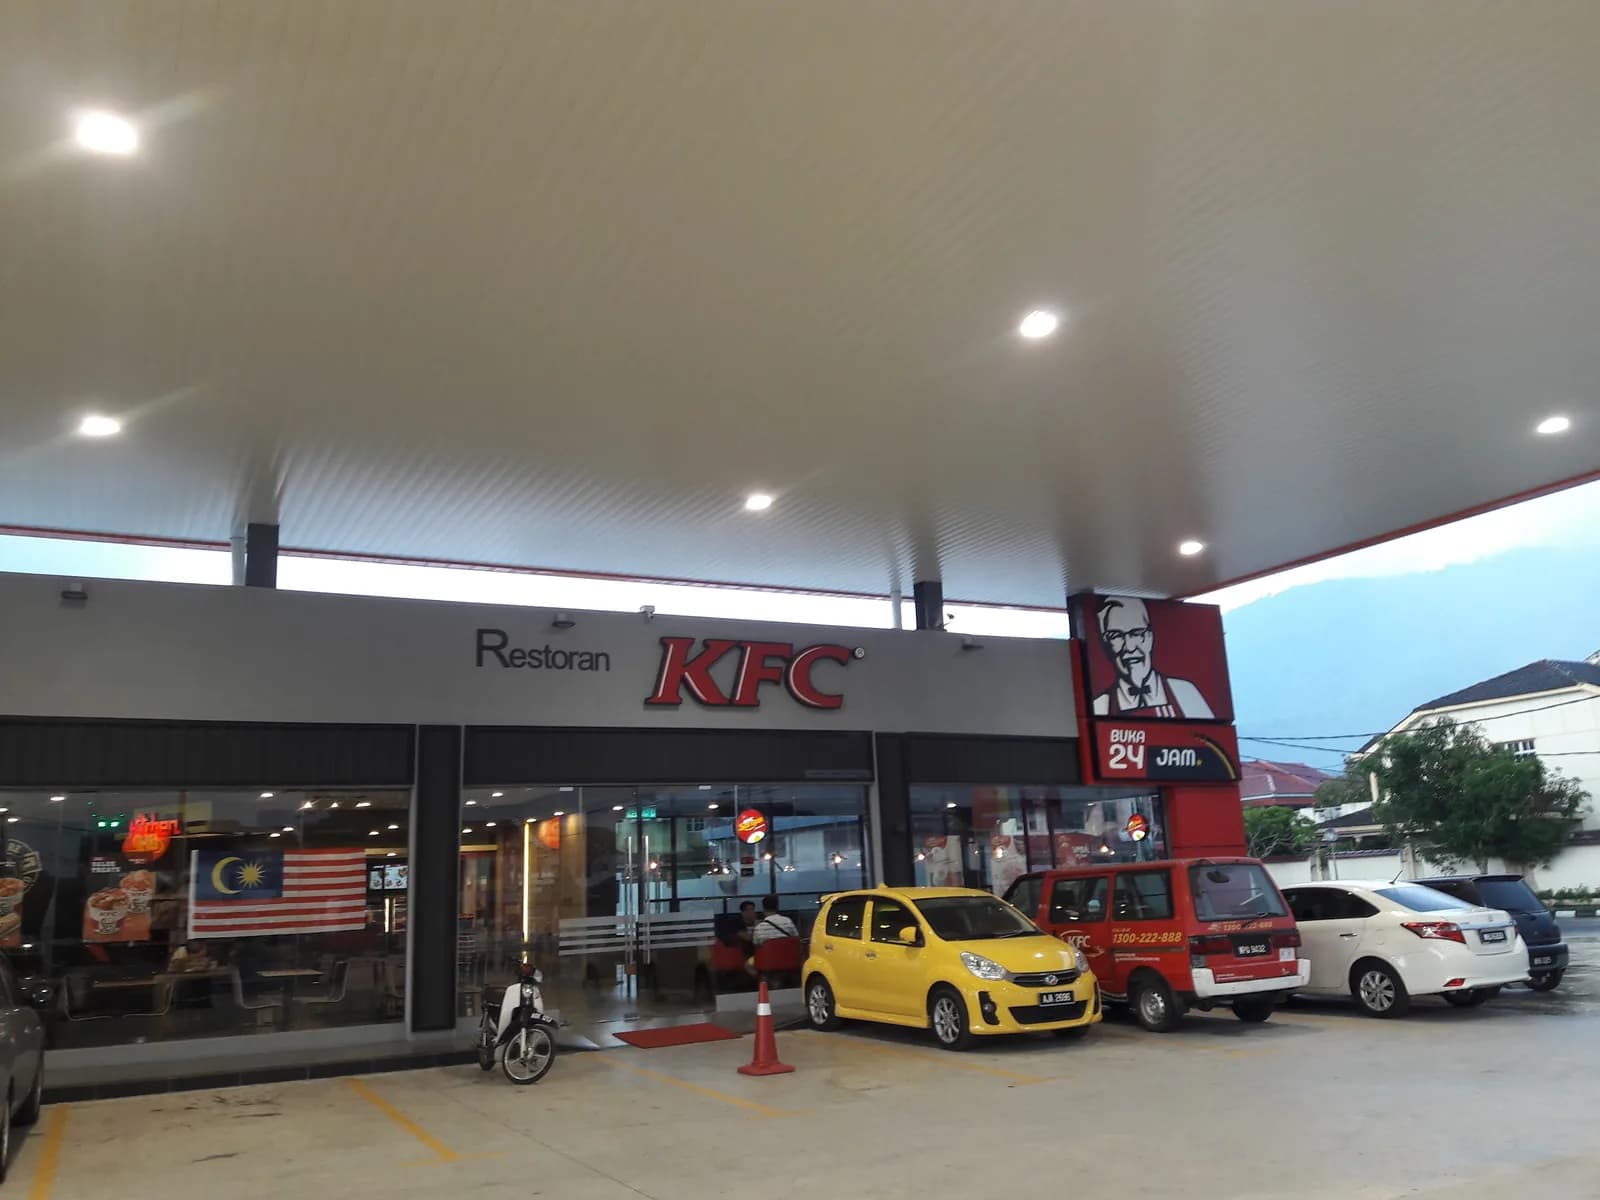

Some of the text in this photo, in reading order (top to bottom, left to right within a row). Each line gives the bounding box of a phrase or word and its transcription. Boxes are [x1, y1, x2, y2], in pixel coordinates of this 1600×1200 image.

[476, 628, 851, 710] Restoran KFC
[1110, 728, 1146, 744] BUKA
[1109, 744, 1145, 769] 24
[1068, 935, 1091, 949] KFC
[1112, 931, 1183, 945] 1300-222-888
